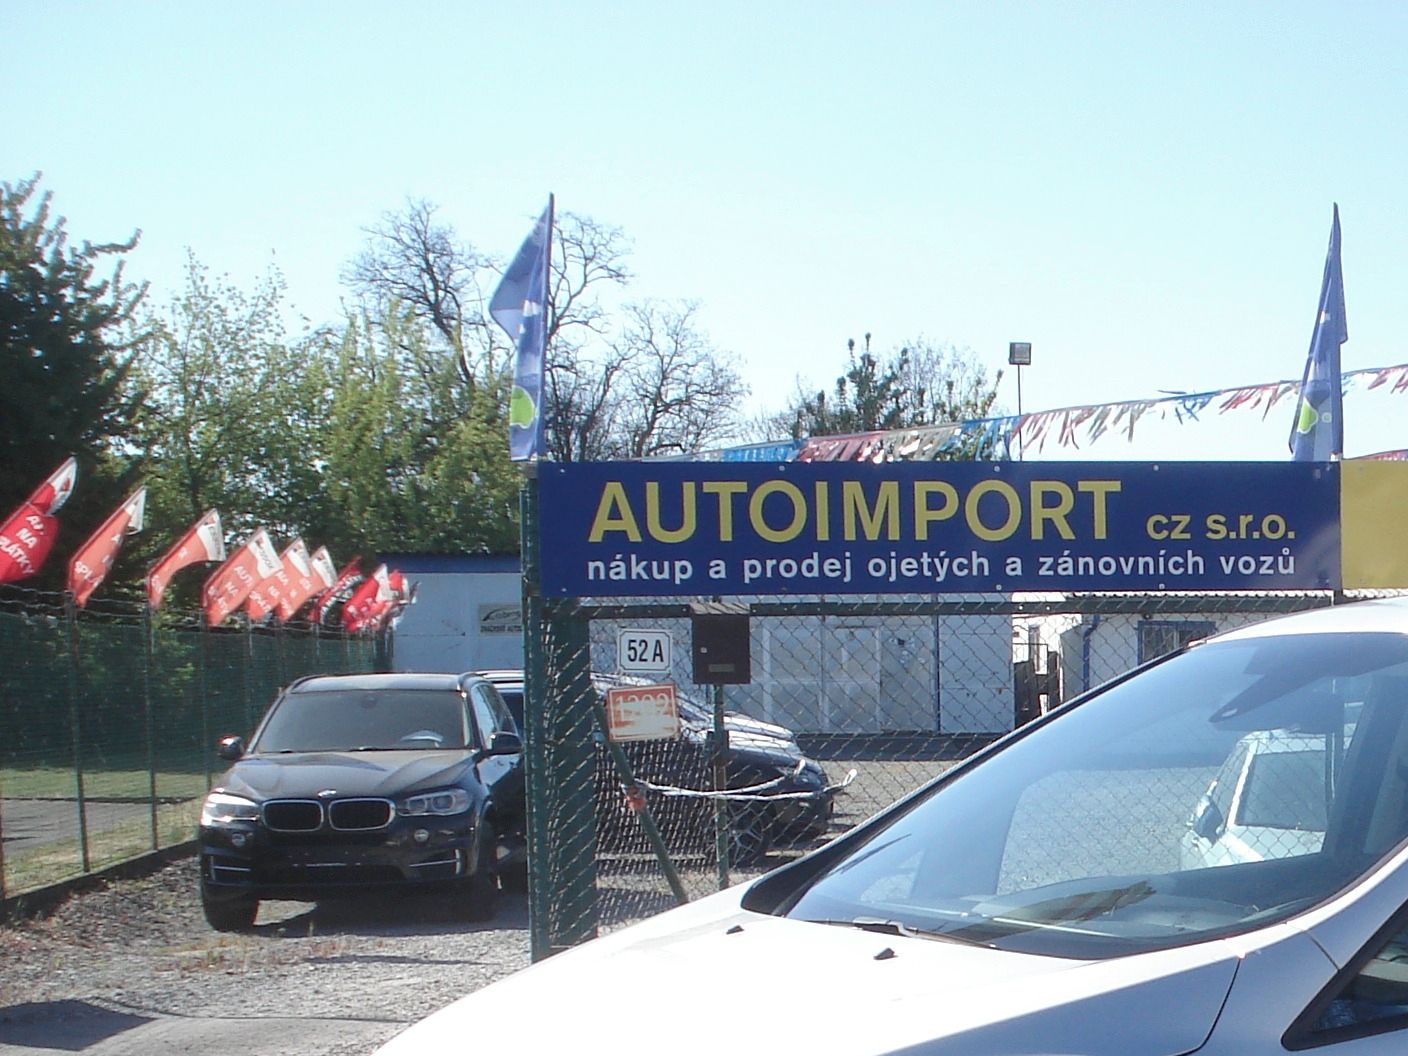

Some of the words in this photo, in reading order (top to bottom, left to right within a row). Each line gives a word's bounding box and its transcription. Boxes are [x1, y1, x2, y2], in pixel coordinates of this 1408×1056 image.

[588, 479, 1122, 543] AUTOIMPORT
[1146, 514, 1191, 540] cz
[1206, 514, 1296, 540] s.r.o.
[588, 554, 693, 584] nákup
[708, 559, 727, 579] a
[744, 552, 852, 583] prodej
[868, 551, 990, 582] ojetých
[1005, 557, 1023, 577] a
[1038, 550, 1204, 576] zánovních
[1220, 547, 1295, 574] vozů
[628, 639, 649, 662] 52
[652, 639, 664, 663] A
